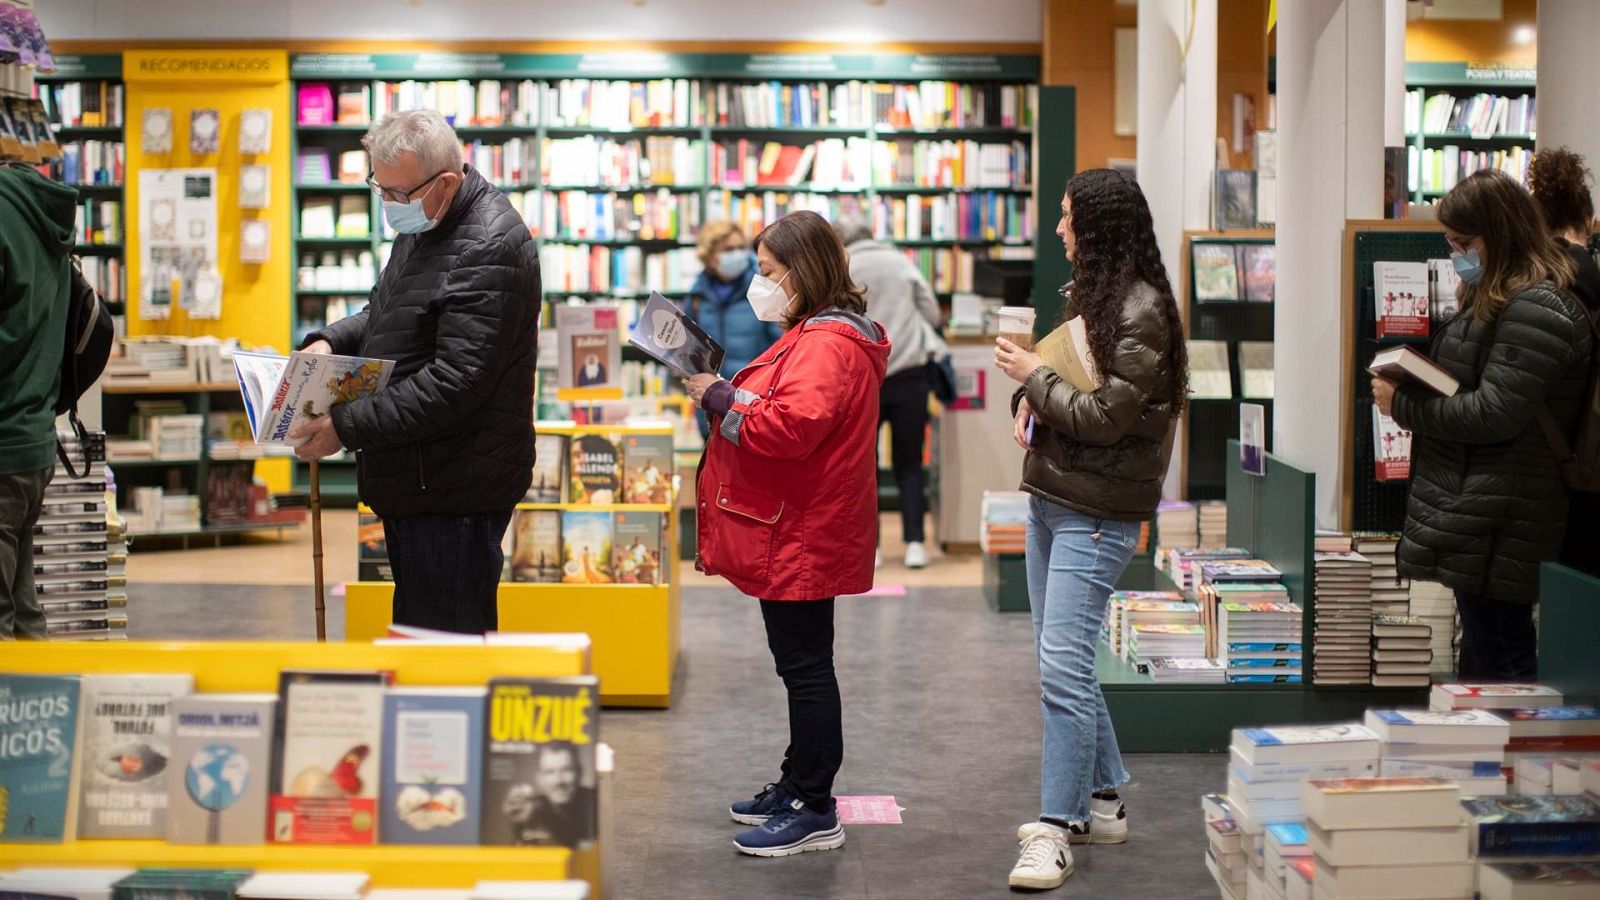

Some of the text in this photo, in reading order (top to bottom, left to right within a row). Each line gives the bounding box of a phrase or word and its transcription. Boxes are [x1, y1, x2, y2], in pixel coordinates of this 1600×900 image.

[139, 57, 272, 73] RECOMENDADOS
[581, 453, 614, 463] ISABEL
[490, 687, 593, 744] UNZUÉ
